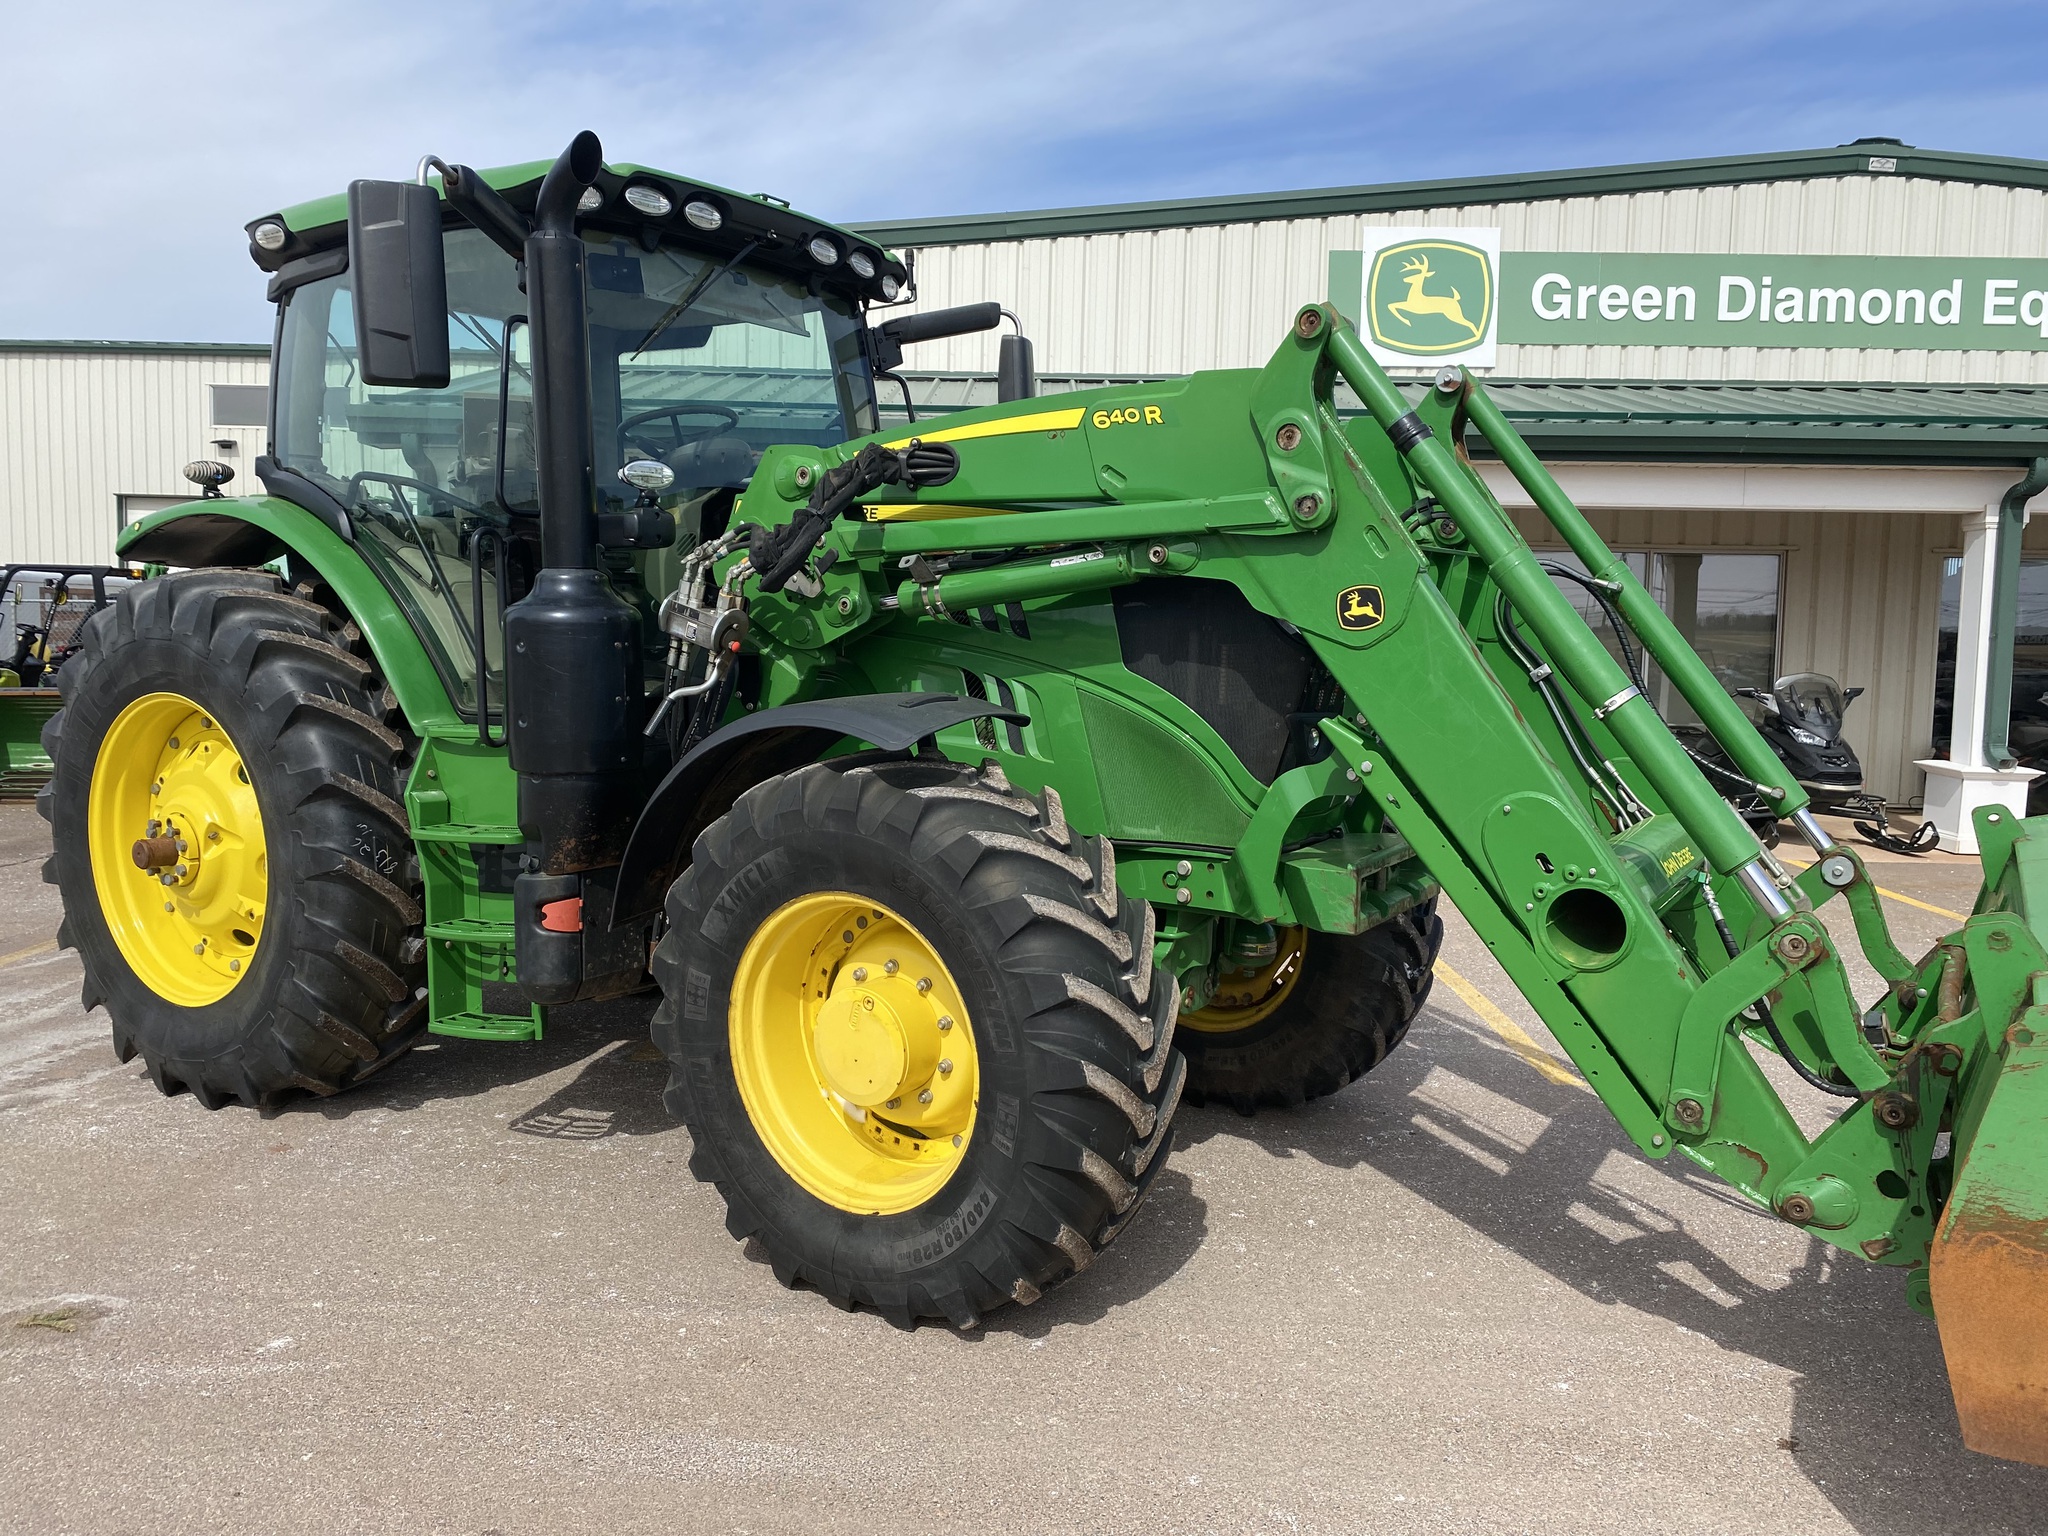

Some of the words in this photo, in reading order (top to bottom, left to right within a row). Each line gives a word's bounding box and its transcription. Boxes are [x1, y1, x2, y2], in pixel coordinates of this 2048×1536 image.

[1531, 272, 1697, 322] Green
[1717, 275, 1963, 326] Diamond
[1983, 279, 2048, 338] Eq
[1671, 846, 1695, 868] DEERE
[944, 1190, 990, 1248] 440/80
[912, 1238, 944, 1264] R28
